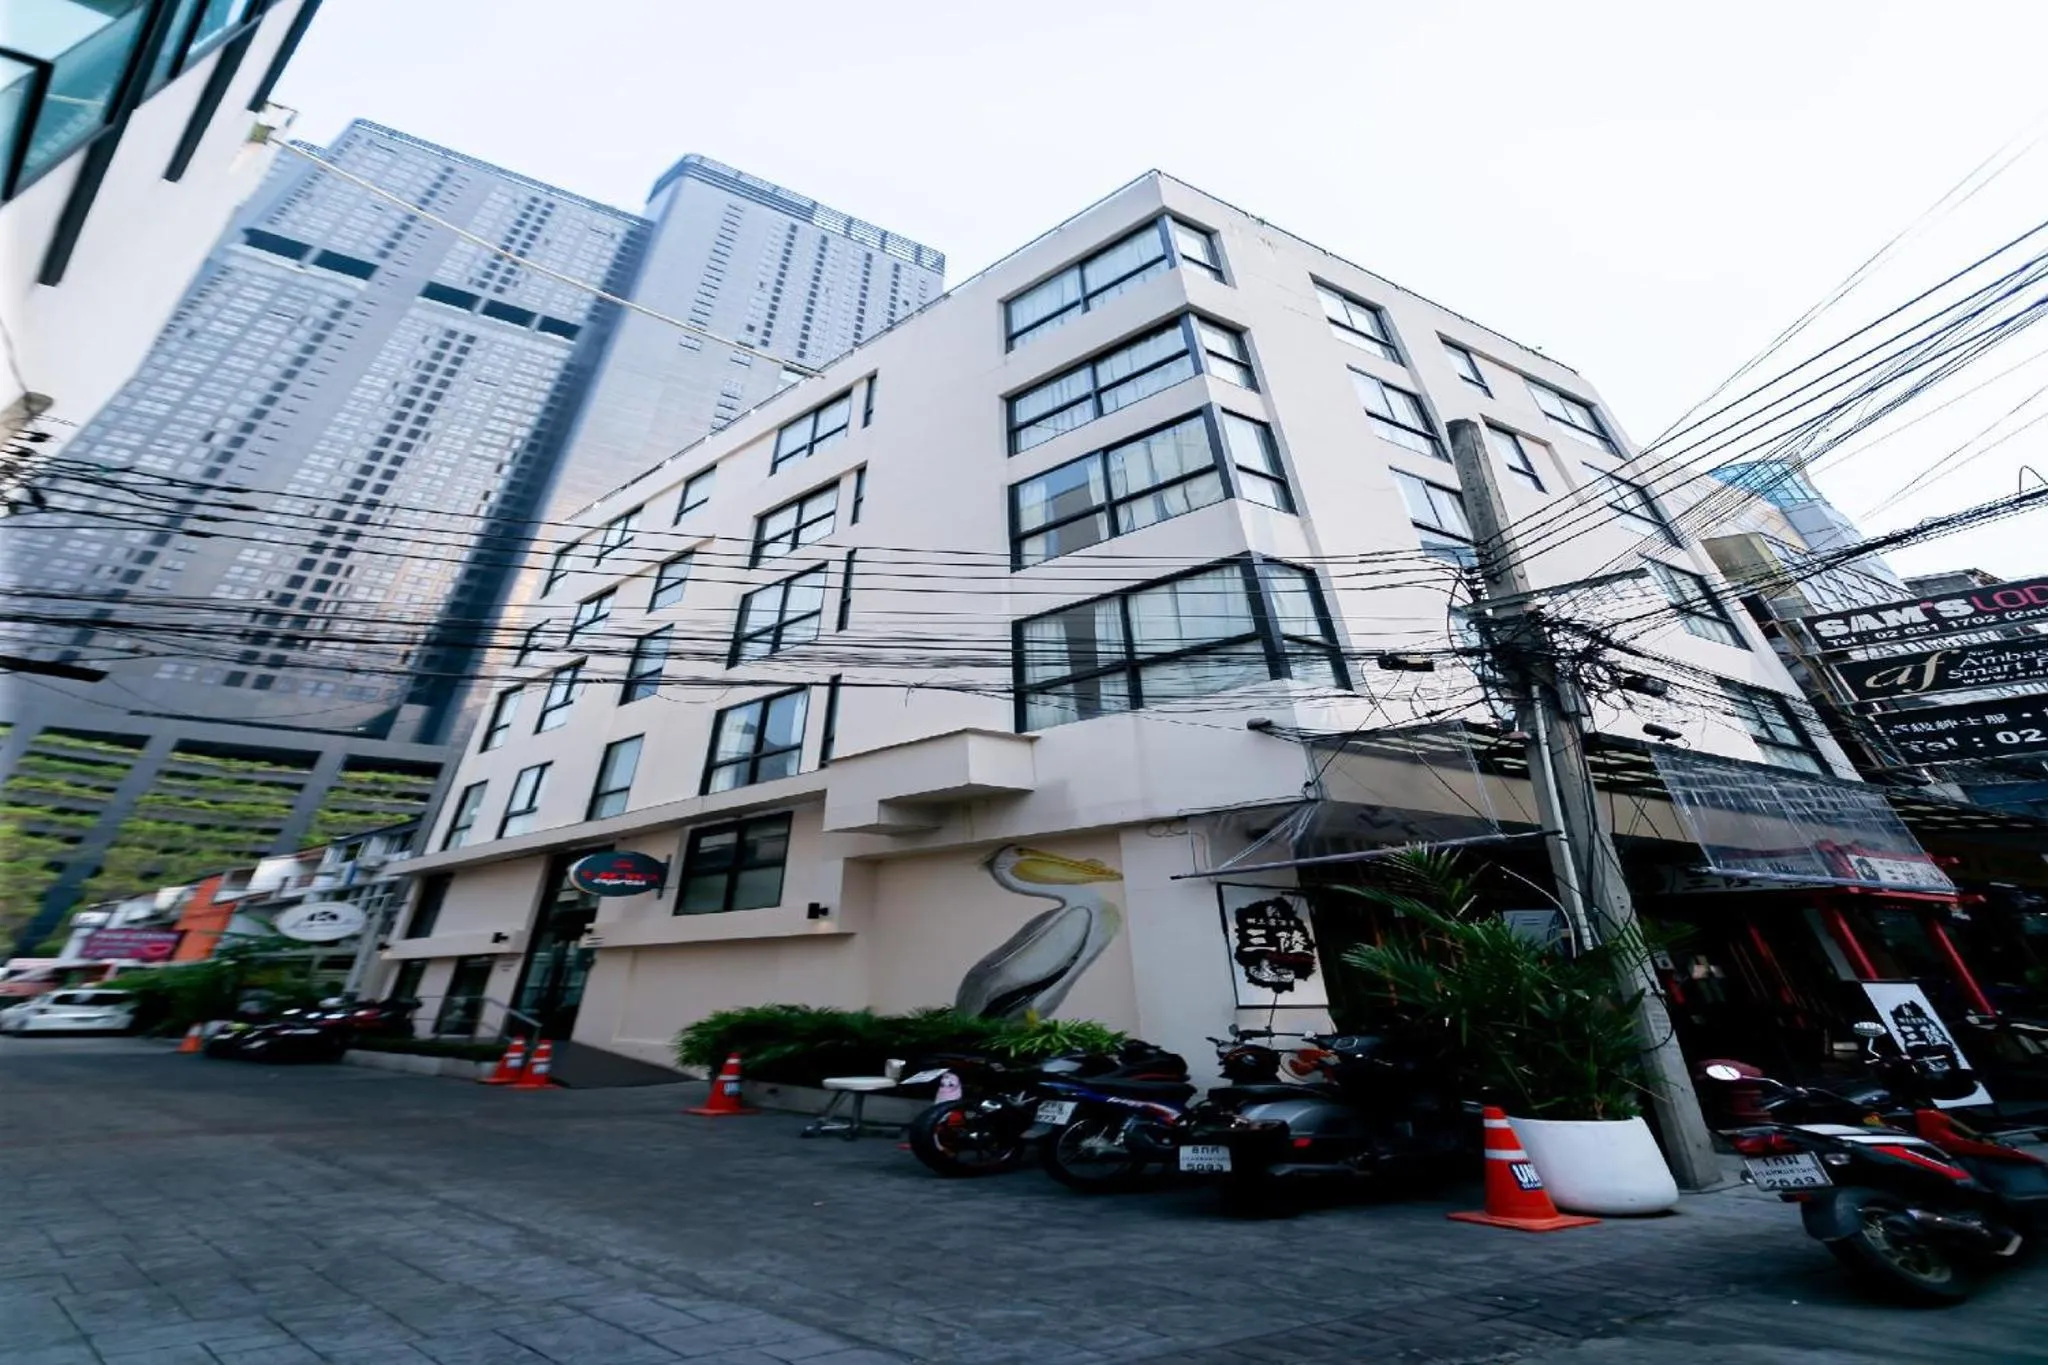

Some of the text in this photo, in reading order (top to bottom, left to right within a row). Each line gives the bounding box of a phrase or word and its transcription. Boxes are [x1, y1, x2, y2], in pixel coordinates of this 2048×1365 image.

[1814, 598, 1975, 637] SAM'S
[1874, 629, 1900, 640] 02
[1904, 623, 1940, 635] 651
[1949, 614, 1998, 629] 1702
[1948, 661, 2025, 680] Smart
[1900, 736, 1959, 753] Tel
[1996, 728, 2048, 744] 02
